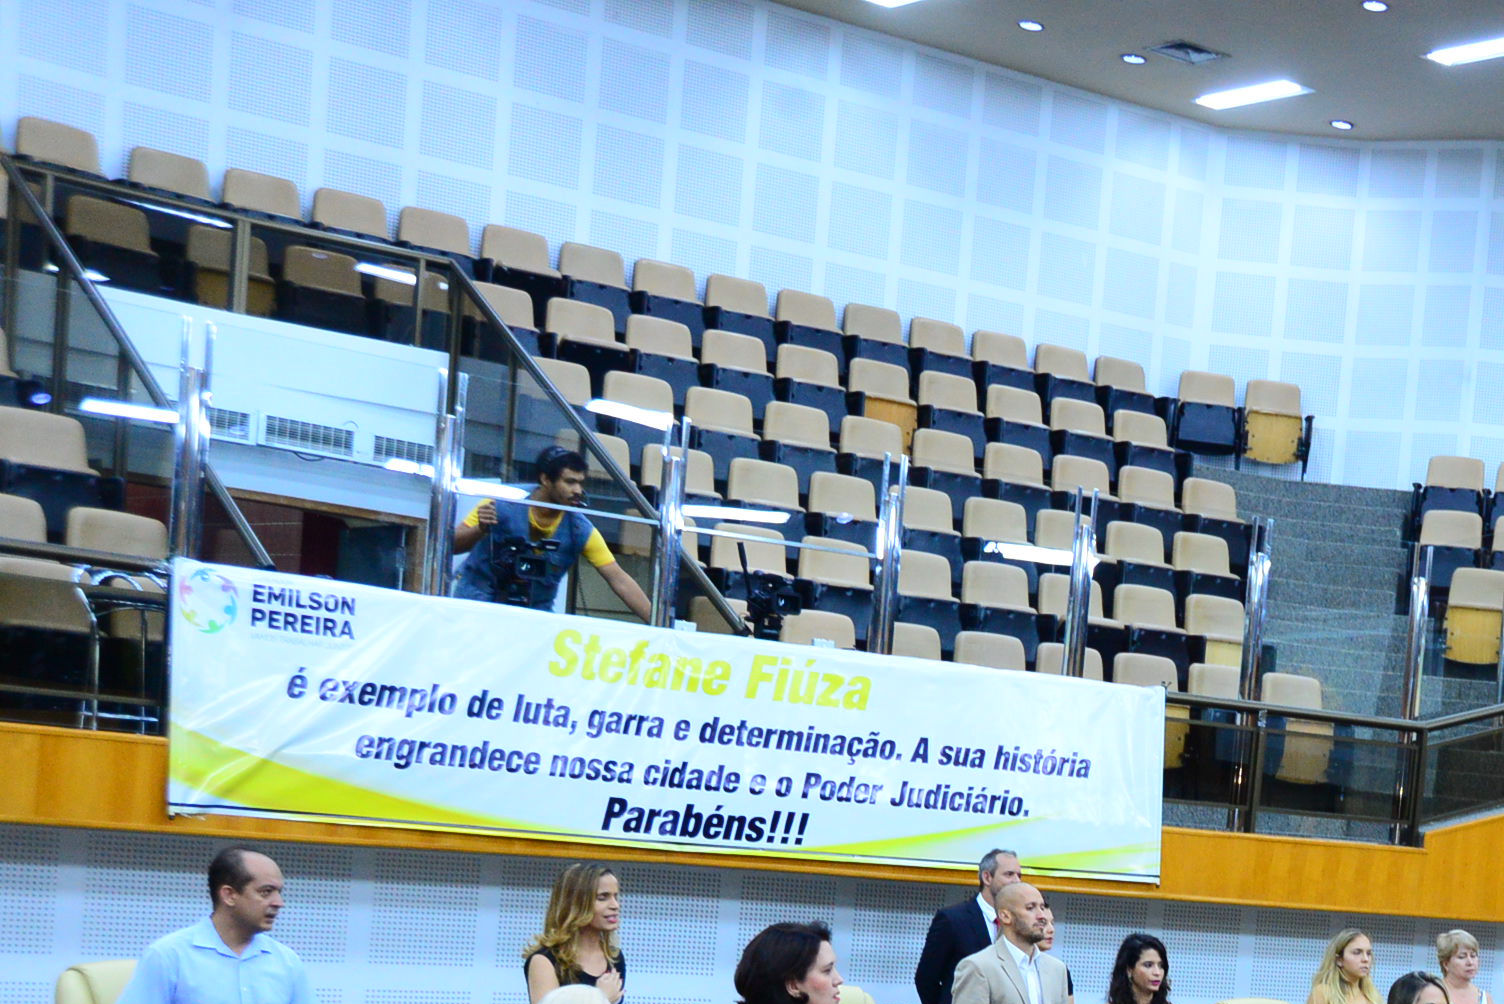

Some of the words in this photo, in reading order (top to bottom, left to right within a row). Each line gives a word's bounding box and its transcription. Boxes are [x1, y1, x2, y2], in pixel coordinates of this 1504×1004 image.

[250, 608, 355, 640] PEREIRA
[252, 583, 356, 616] EMILSON
[548, 629, 732, 695] Stefane
[744, 654, 872, 711] Fiúza
[287, 666, 308, 699] é
[318, 677, 458, 718] exemplo
[467, 689, 504, 720] de
[513, 694, 578, 735] luta,
[586, 707, 665, 739] garra
[673, 718, 691, 741] e
[698, 716, 902, 766] determinação.
[911, 737, 930, 764] A
[938, 745, 986, 769] sua
[994, 744, 1092, 779] história
[355, 732, 541, 775] engrandece
[549, 754, 634, 784] nossa
[643, 759, 741, 793] cidade
[748, 773, 767, 796] e
[775, 775, 793, 798] o
[801, 772, 884, 805] Poder
[890, 781, 1030, 817] Judiciário.
[601, 796, 810, 845] Parabéns!!!
